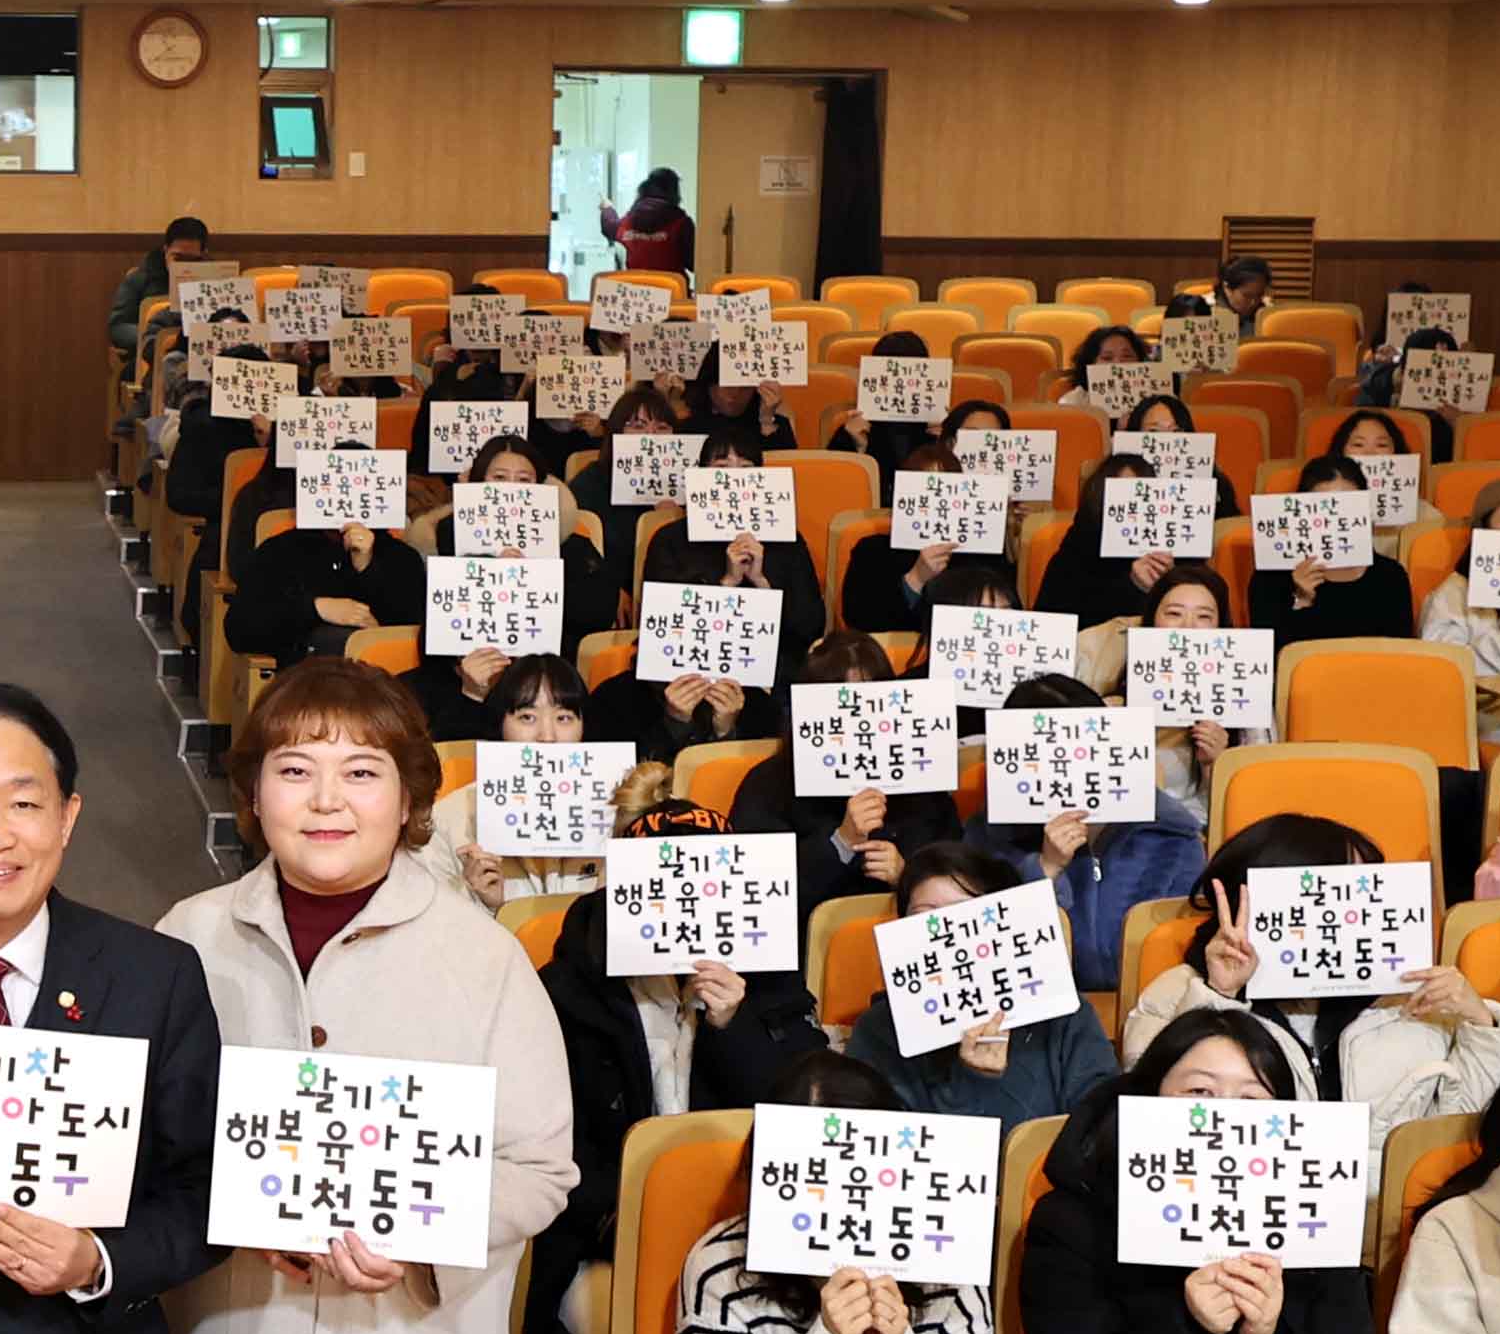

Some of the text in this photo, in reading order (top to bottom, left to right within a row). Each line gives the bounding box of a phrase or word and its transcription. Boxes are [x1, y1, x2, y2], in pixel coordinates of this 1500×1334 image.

[296, 1058, 424, 1120] 활기찬
[822, 1112, 935, 1164] 활기찬
[1188, 1102, 1305, 1152] 활기찬
